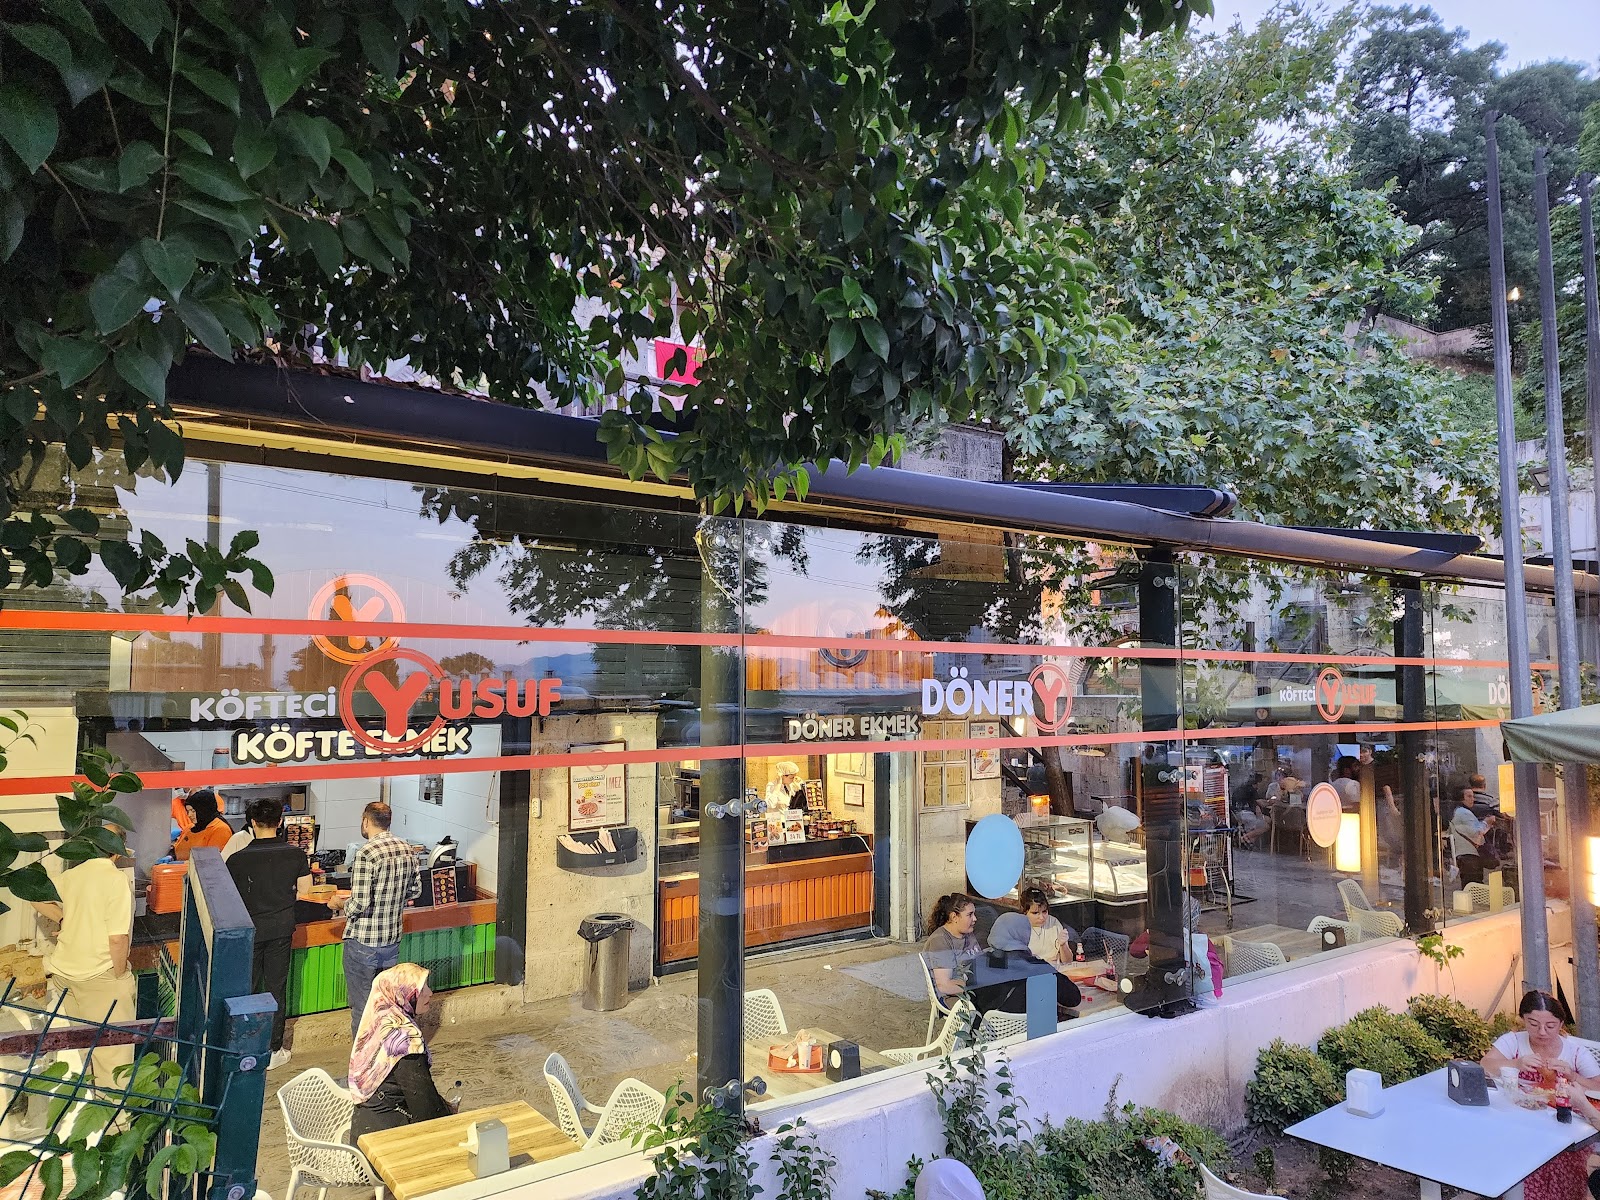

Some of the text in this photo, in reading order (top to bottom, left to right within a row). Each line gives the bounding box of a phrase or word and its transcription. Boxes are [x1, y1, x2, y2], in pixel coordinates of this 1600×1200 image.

[190, 686, 336, 722] KÖFTECİ
[922, 666, 1035, 716] DÖNER
[1280, 686, 1316, 702] KÖFTECİ
[1488, 674, 1511, 705] DÖ
[237, 722, 356, 761] KÖFTE
[788, 713, 919, 741] DÖNER EKMEK
